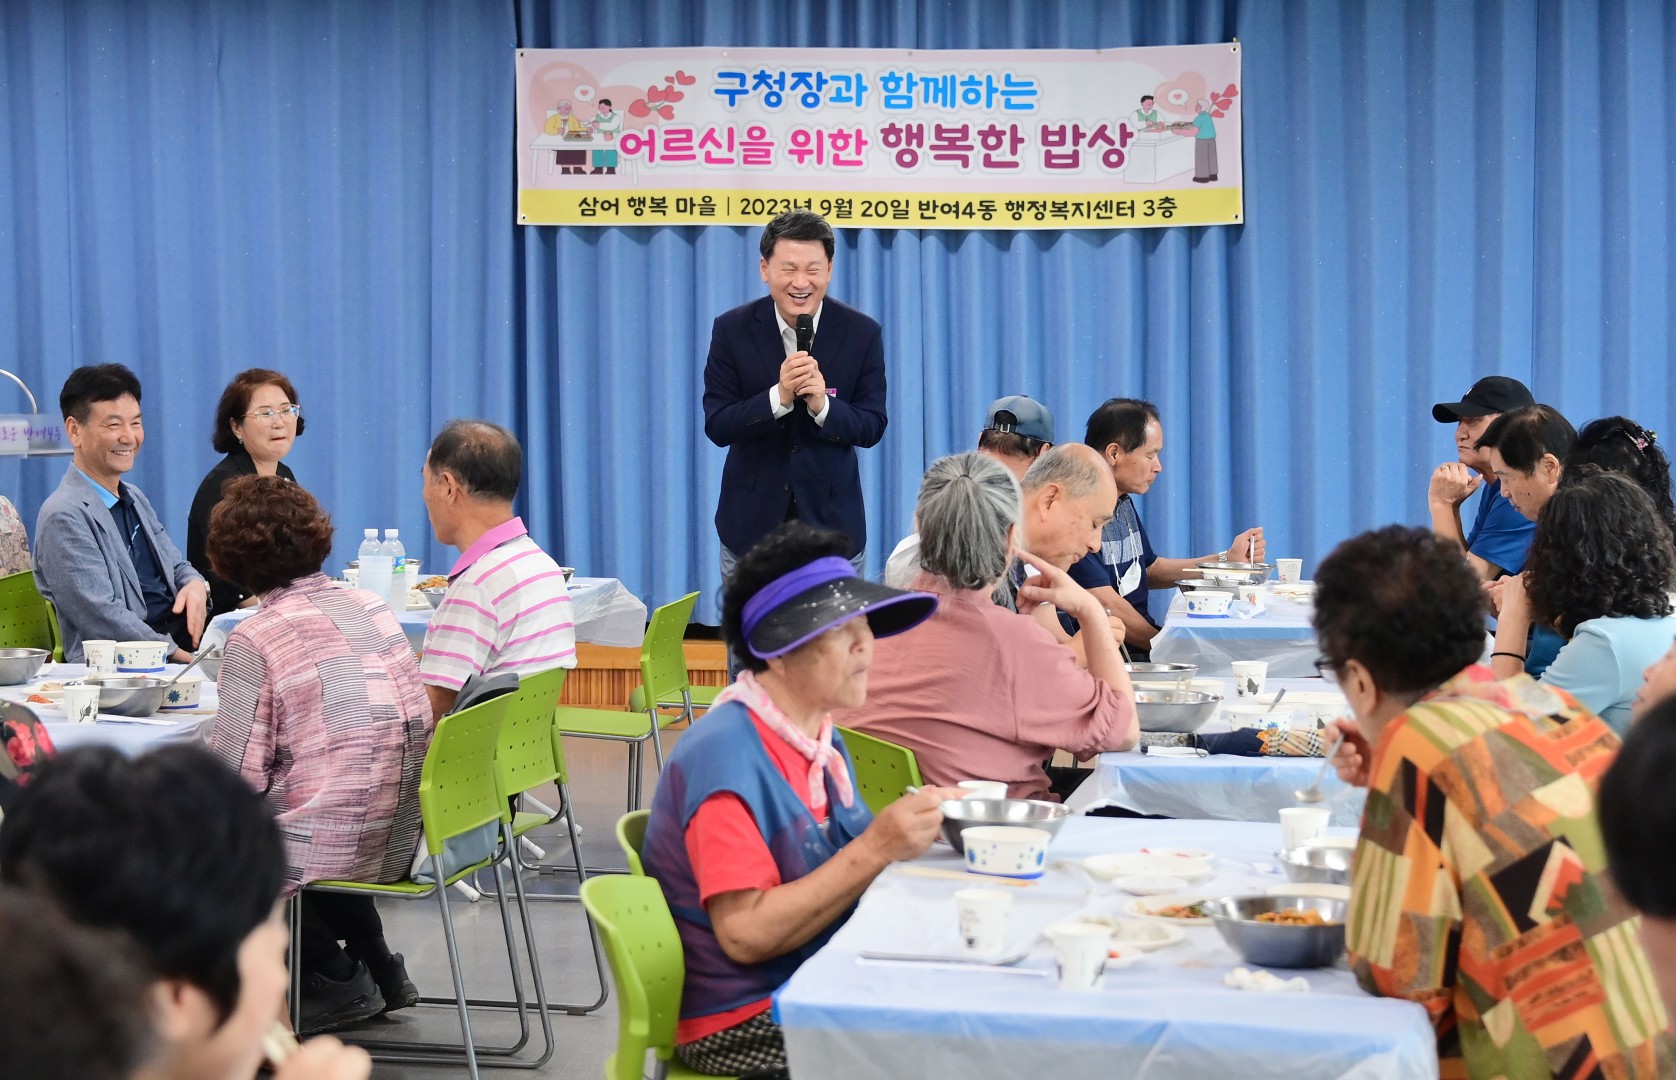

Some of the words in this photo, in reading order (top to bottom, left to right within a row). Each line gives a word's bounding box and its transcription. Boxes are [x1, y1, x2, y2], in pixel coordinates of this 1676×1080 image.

[713, 69, 869, 109] 구청장과
[879, 70, 1038, 110] 함께하는
[619, 125, 775, 164] 어르신을
[787, 128, 869, 167] 위한
[880, 122, 1025, 169] 행복한
[1040, 122, 1134, 169] 밥상
[578, 196, 619, 217] 삼어
[627, 196, 669, 217] 행복
[675, 195, 717, 217] 마을
[819, 197, 853, 219] 9월
[860, 199, 910, 220] 20일
[918, 199, 998, 221] 반여4동
[1004, 199, 1135, 221] 행정복지센터
[1143, 196, 1178, 218] 3층
[0, 426, 17, 441] 로운
